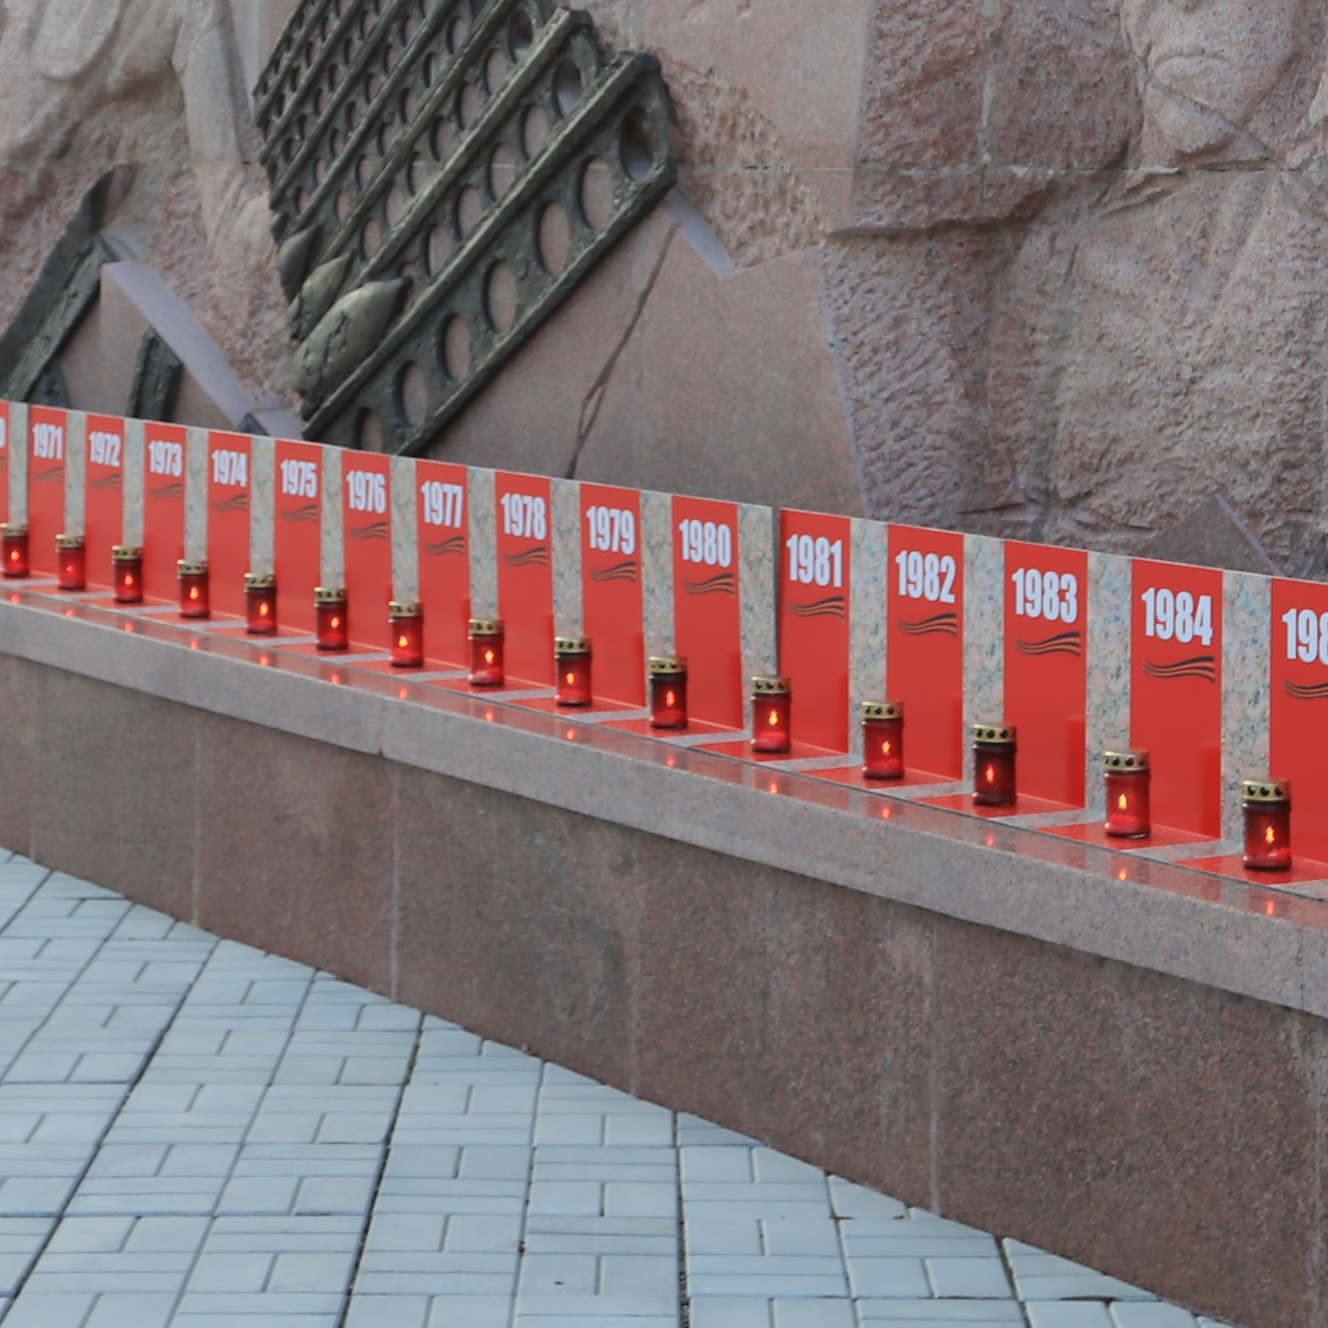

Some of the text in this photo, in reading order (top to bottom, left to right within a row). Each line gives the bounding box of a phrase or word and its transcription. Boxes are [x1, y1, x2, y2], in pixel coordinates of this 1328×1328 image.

[32, 422, 63, 460] 1971
[89, 431, 121, 468] 1972
[148, 440, 183, 478] 1973
[211, 449, 248, 488] 1974
[280, 459, 318, 499] 1975
[345, 470, 387, 515] 1976
[420, 480, 464, 529] 1977
[500, 492, 547, 541] 1978
[585, 504, 636, 556] 1979
[678, 518, 732, 569] 1980
[785, 534, 843, 589] 1981
[894, 550, 957, 605] 1982
[1011, 567, 1079, 624] 1983
[1140, 587, 1214, 647] 1984
